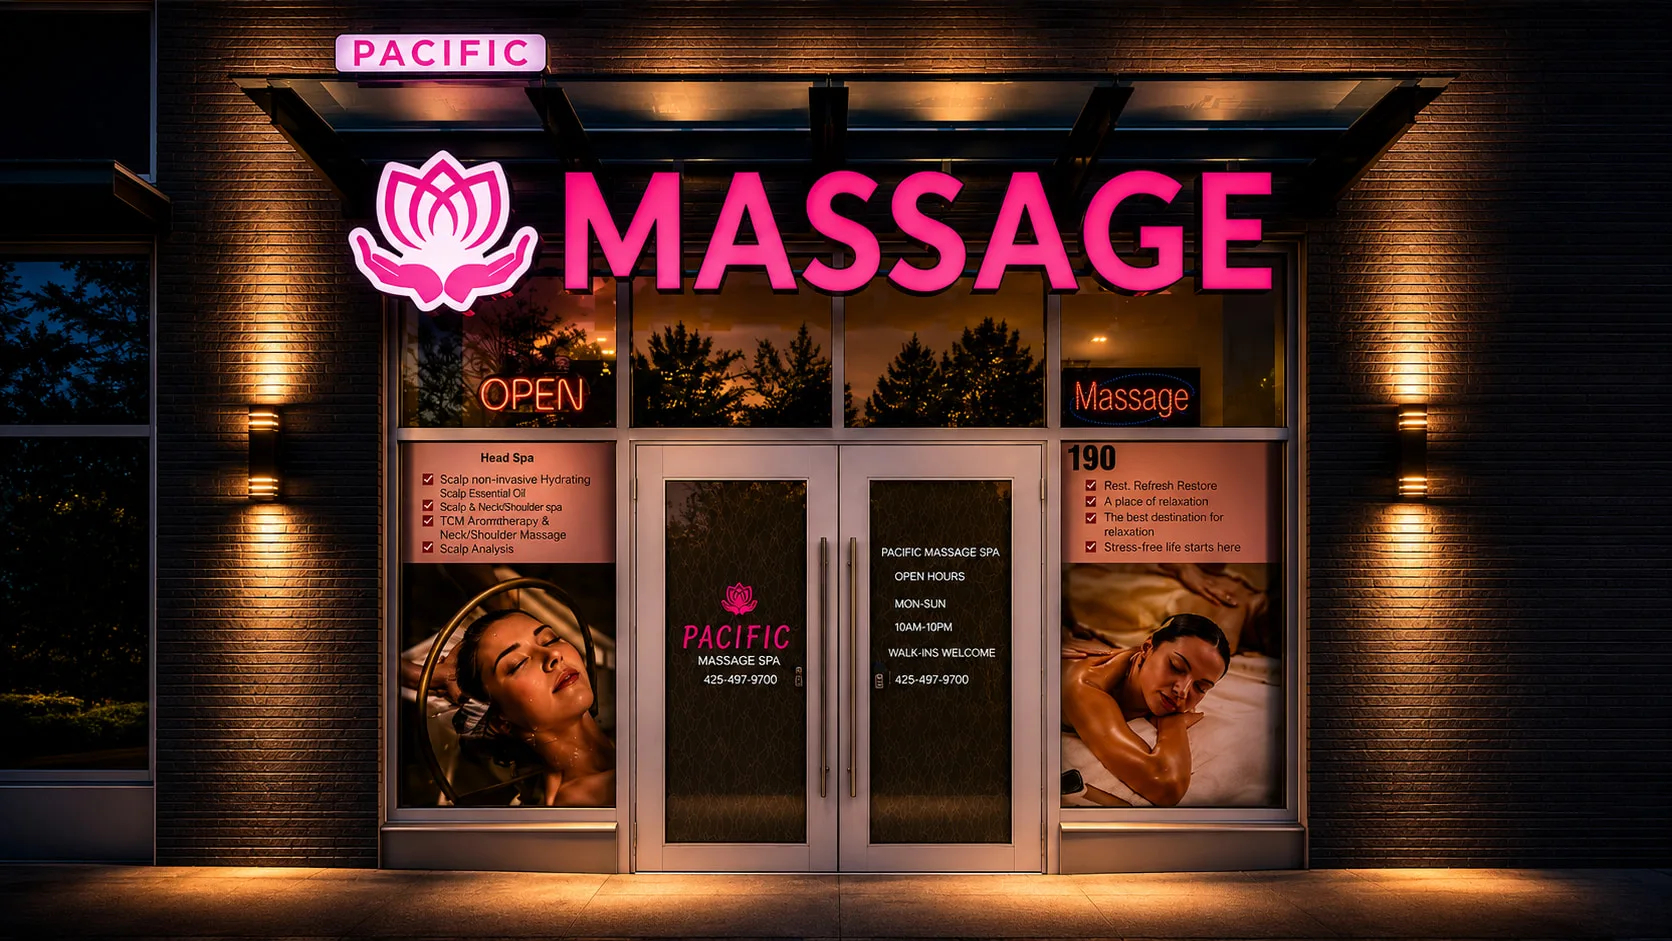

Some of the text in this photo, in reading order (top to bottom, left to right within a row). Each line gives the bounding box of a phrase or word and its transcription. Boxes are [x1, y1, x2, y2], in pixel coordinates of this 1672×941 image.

[353, 39, 529, 67] PACIFIC
[565, 170, 1272, 294] MASSAGE
[481, 378, 583, 411] OPEN
[1076, 381, 1189, 418] Massage
[481, 453, 534, 465] Head Spa
[1068, 444, 1115, 471] 190
[440, 475, 590, 486] Scalp non-invasive Hydrating
[1134, 480, 1174, 490] Refresh
[1178, 481, 1217, 490] Restore
[440, 489, 525, 499] Scalp Essential Oil
[440, 503, 466, 513] Scalp
[469, 502, 476, 512] &
[546, 504, 562, 513] spa
[1104, 497, 1208, 508] A place of relaxation
[441, 516, 464, 525] TCM
[542, 516, 550, 525] &
[1104, 512, 1224, 522] The best destination for
[440, 530, 566, 542] Neck/Shoulder Massage
[1104, 527, 1154, 537] relaxation
[440, 544, 514, 556] Scalp Analysis
[882, 547, 1000, 557] PACIFIC MASSAGE SPA
[1104, 542, 1241, 552] Stress-free life starts here
[895, 571, 965, 581] OPEN HOURS
[895, 599, 946, 609] MON-SUN
[895, 622, 953, 632] 10AM-10PM
[682, 624, 791, 650] PACIFIC
[888, 648, 995, 658] WALK-INS WELCOME
[698, 656, 780, 666] MASSAGE SPA
[704, 674, 778, 685] 425-497-9700
[895, 674, 969, 685] 425-497-9700
